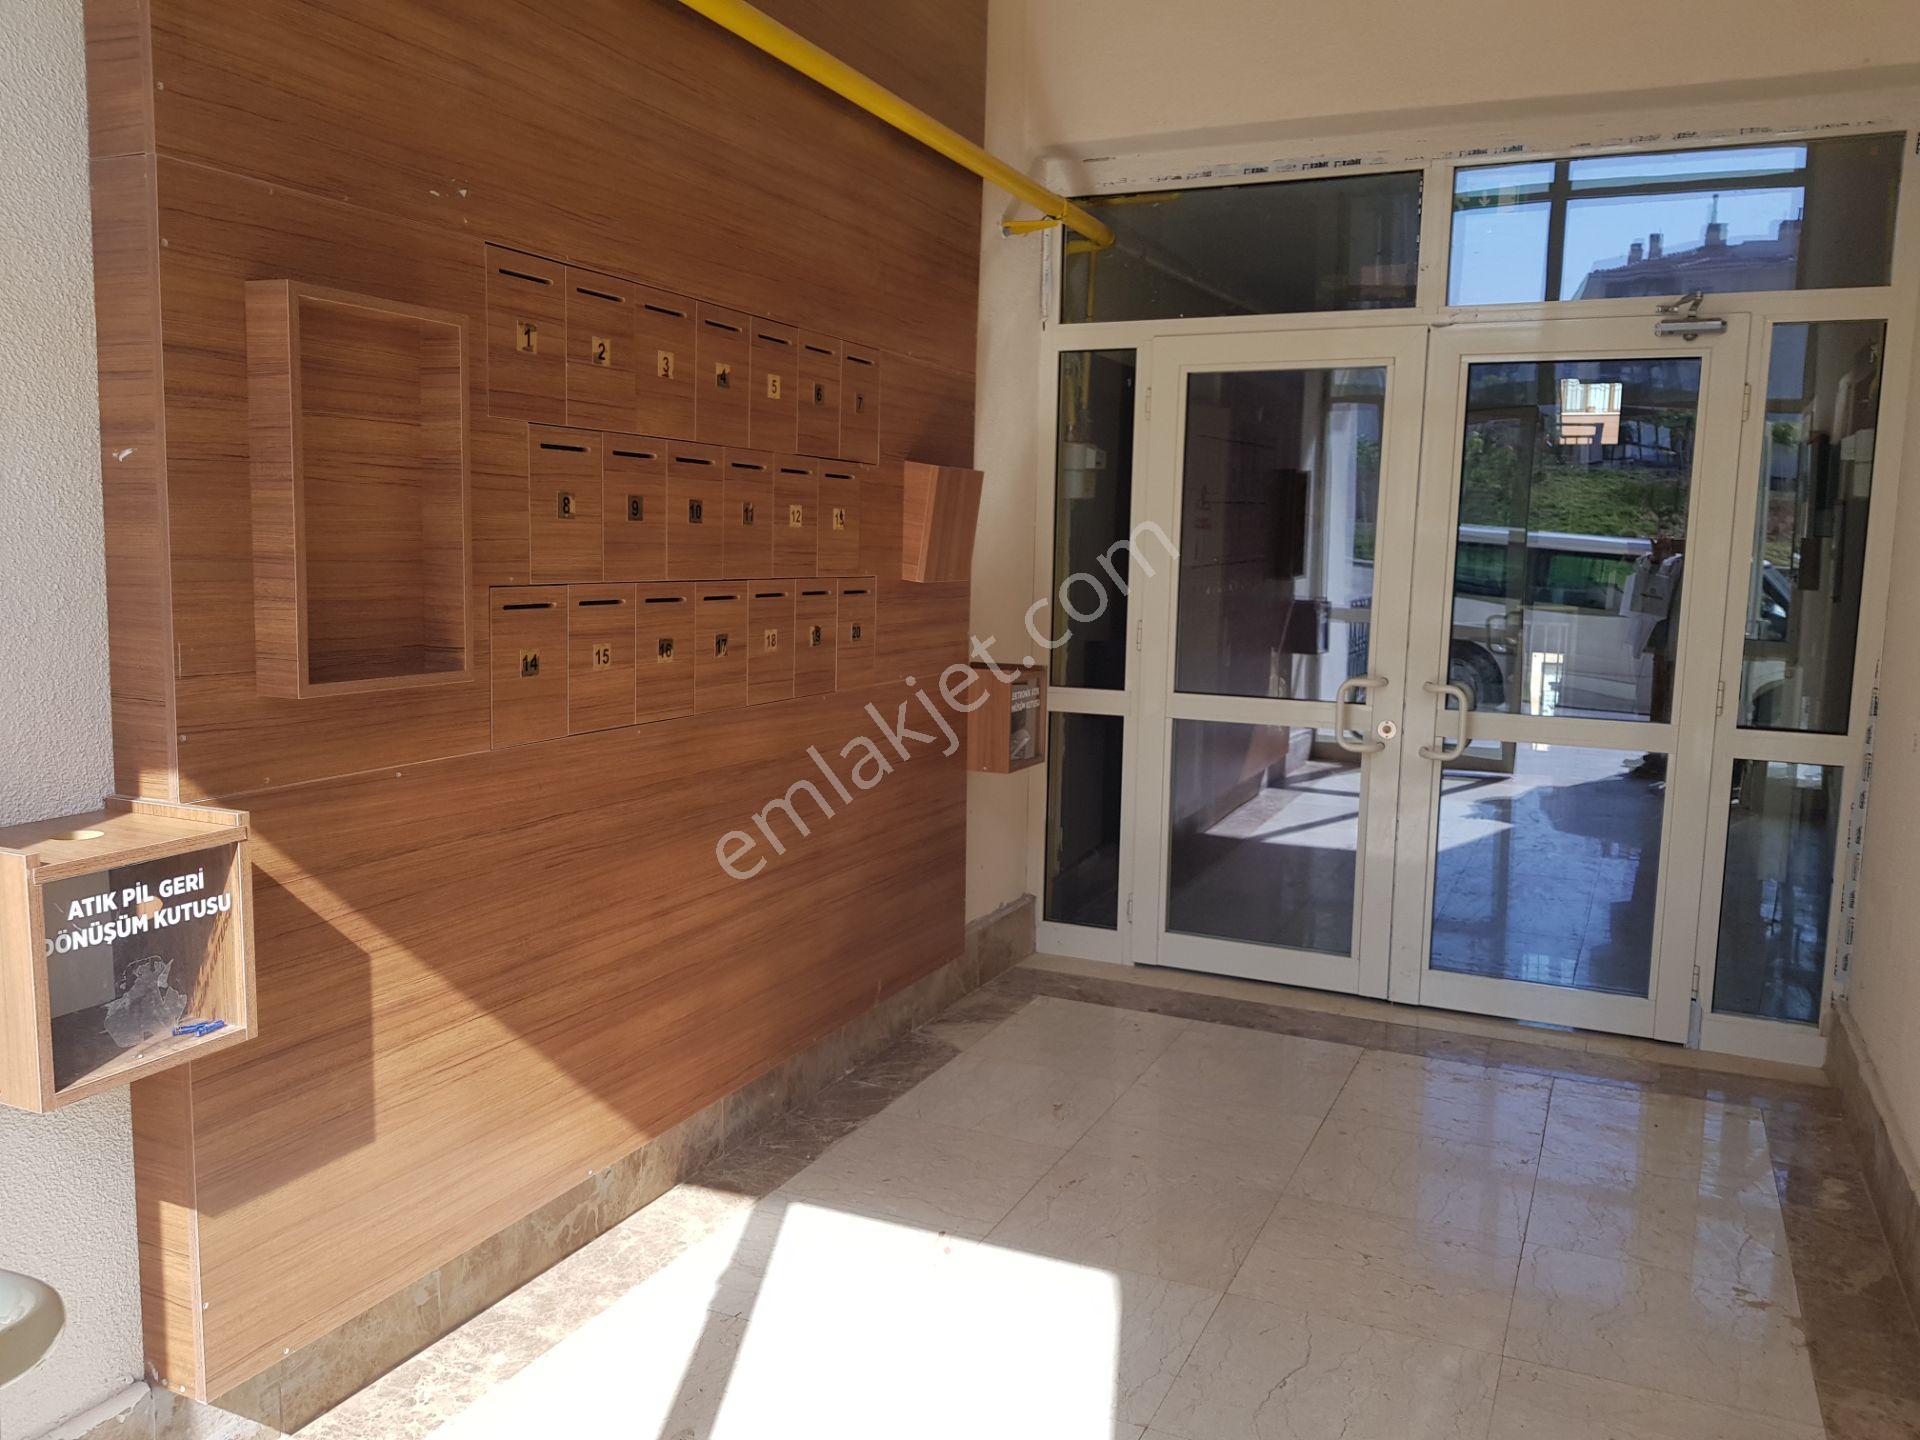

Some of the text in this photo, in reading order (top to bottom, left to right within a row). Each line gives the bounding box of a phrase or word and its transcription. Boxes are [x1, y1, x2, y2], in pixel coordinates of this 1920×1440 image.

[598, 342, 606, 361] 2
[562, 496, 571, 514] 8
[631, 499, 639, 517] 9
[688, 504, 702, 520] 10
[791, 510, 801, 524] 12
[766, 633, 777, 649] 18
[852, 626, 861, 639] 20
[522, 653, 539, 672] 14
[595, 648, 610, 665] 15
[67, 867, 205, 921] ATIK PİL GERİ
[153, 893, 232, 930] KUTUSU
